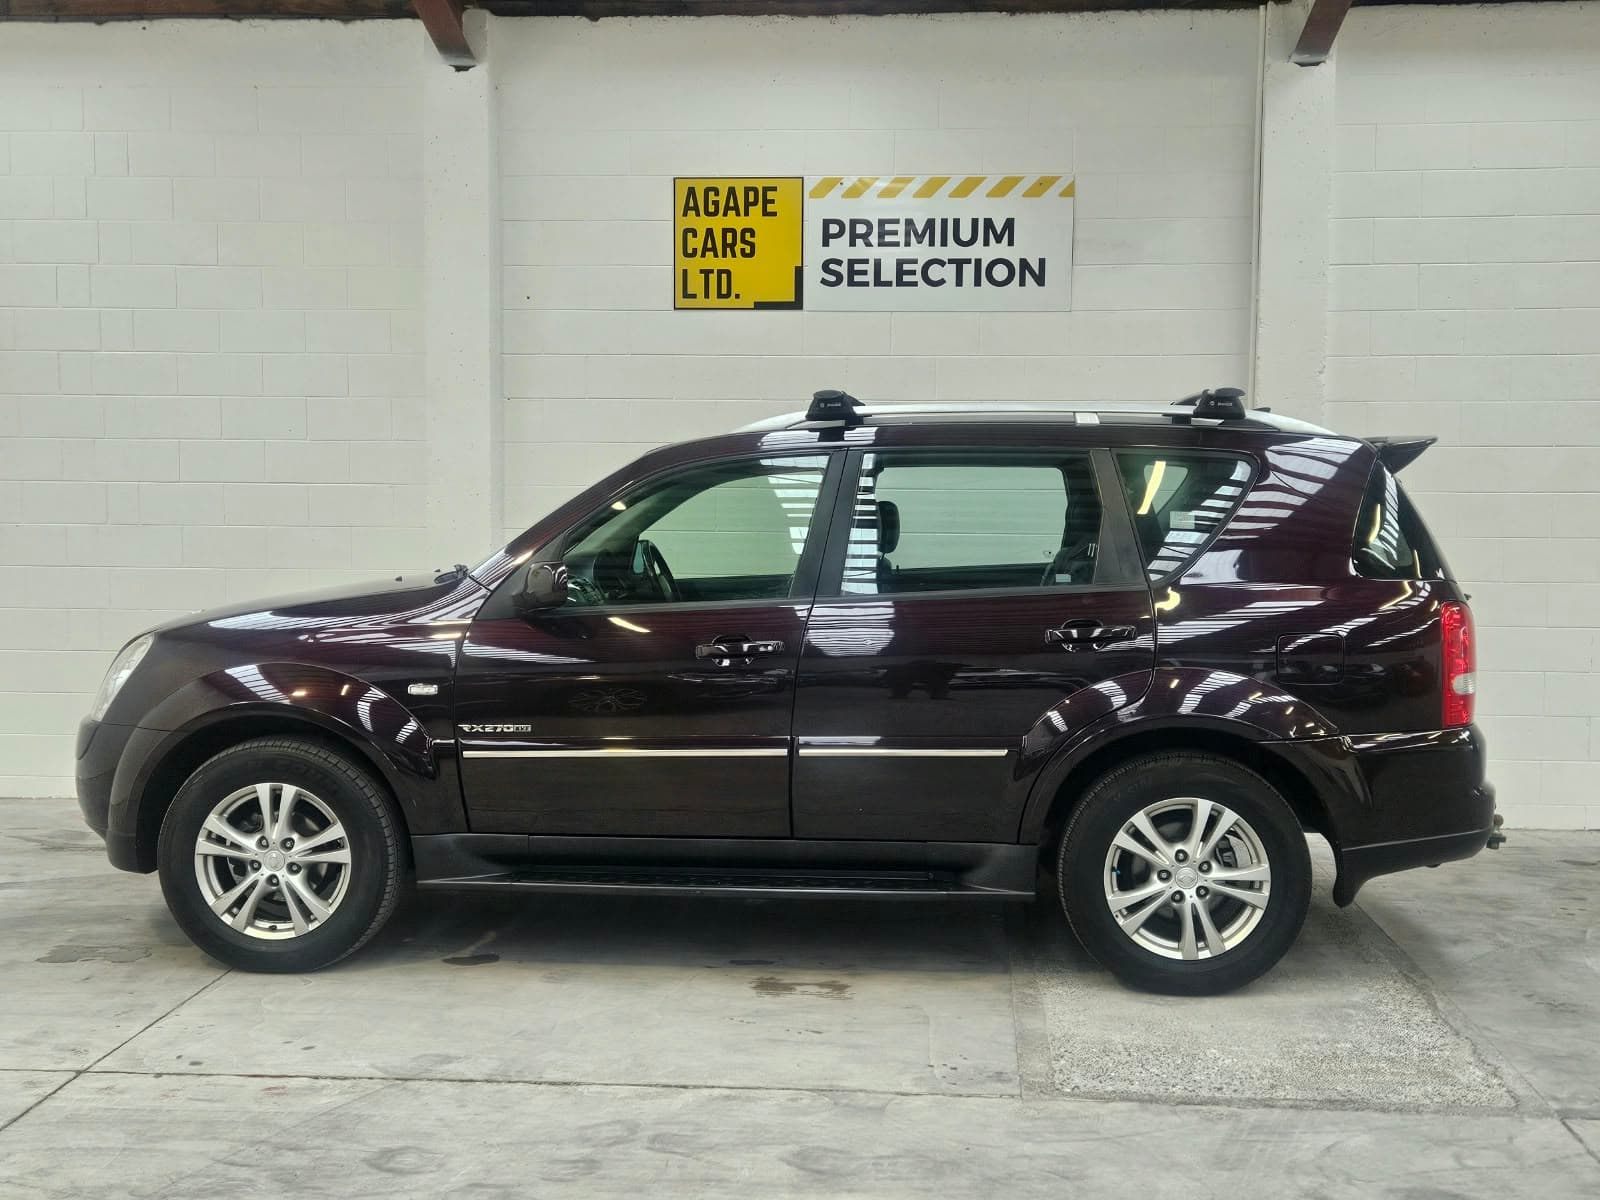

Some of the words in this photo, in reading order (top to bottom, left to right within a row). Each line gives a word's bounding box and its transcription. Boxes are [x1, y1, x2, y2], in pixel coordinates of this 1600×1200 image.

[682, 186, 778, 217] AGAPE
[682, 228, 756, 258] CARS
[821, 218, 1015, 247] PREMIUM
[682, 269, 741, 299] LTD.
[820, 258, 1046, 287] SELECTION
